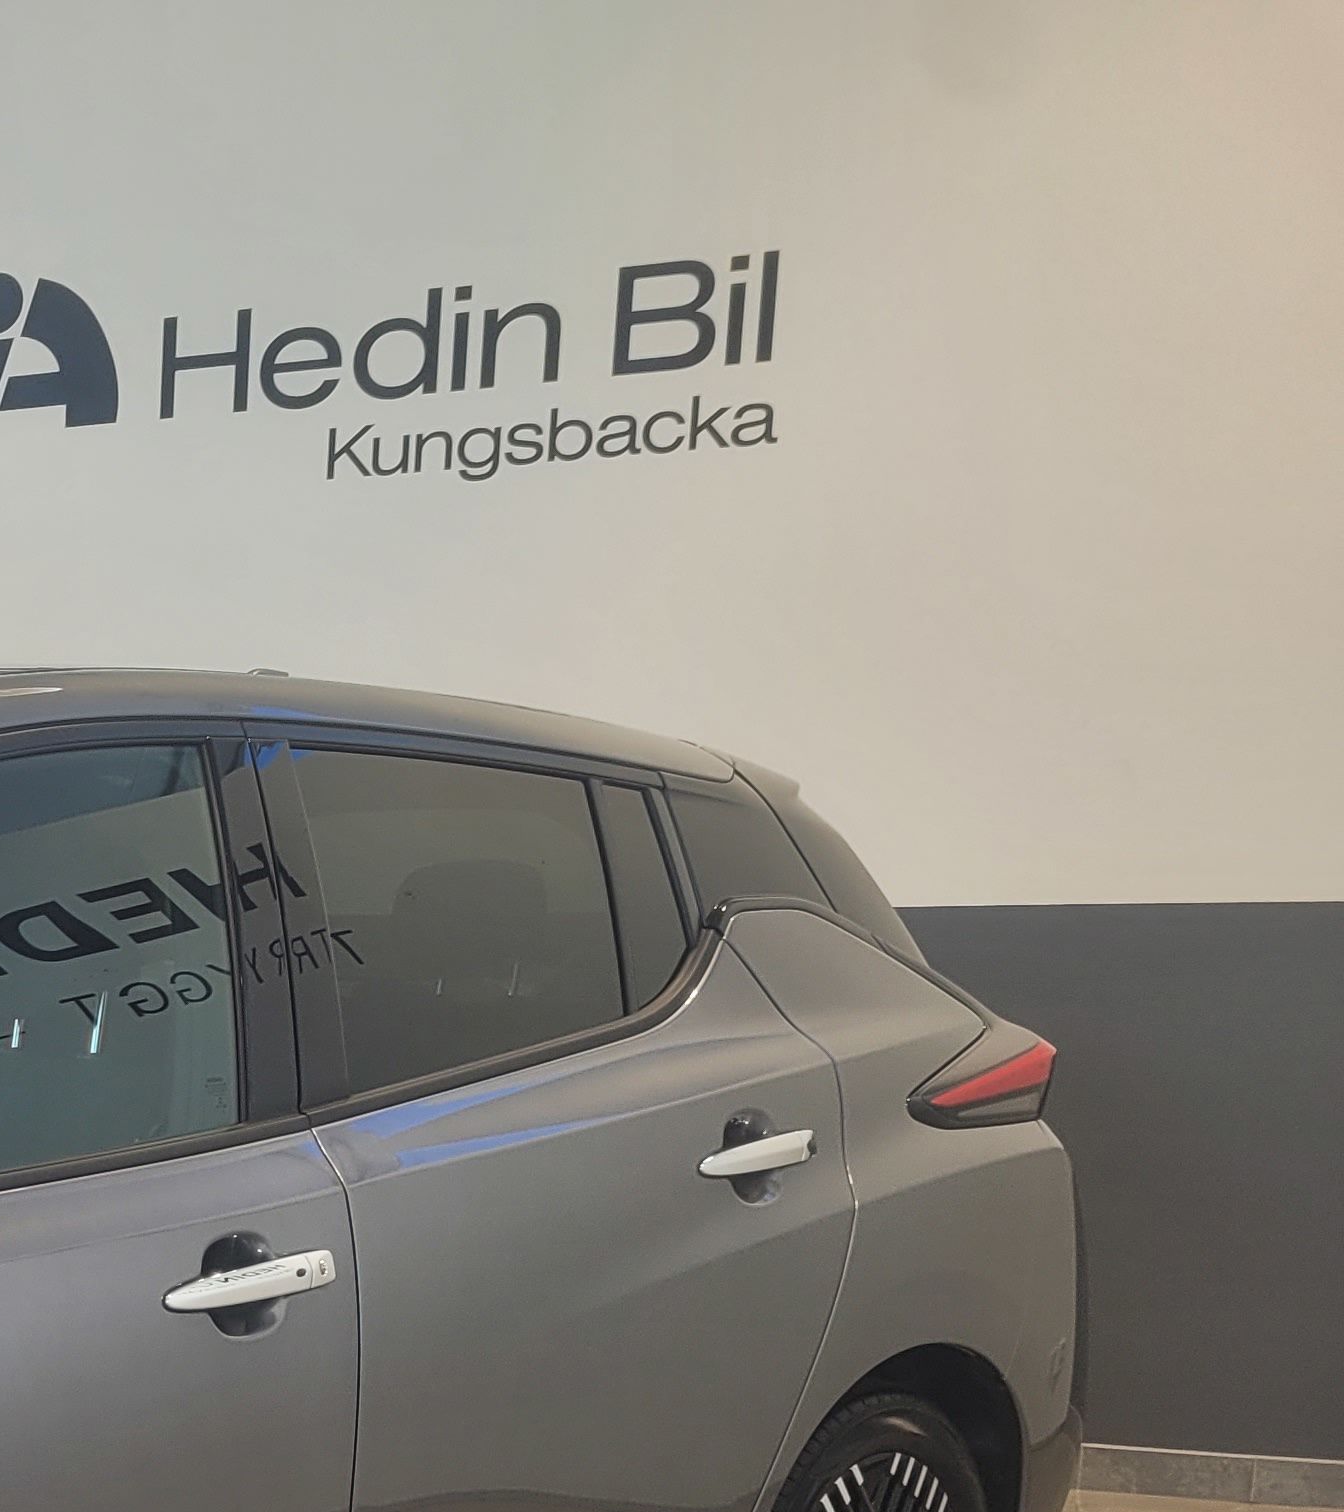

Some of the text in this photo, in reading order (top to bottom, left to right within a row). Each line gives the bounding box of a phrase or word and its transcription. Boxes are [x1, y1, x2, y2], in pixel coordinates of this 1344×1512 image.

[159, 284, 562, 420] Hedin
[611, 249, 781, 376] Bil
[324, 395, 778, 482] Kungsbacka
